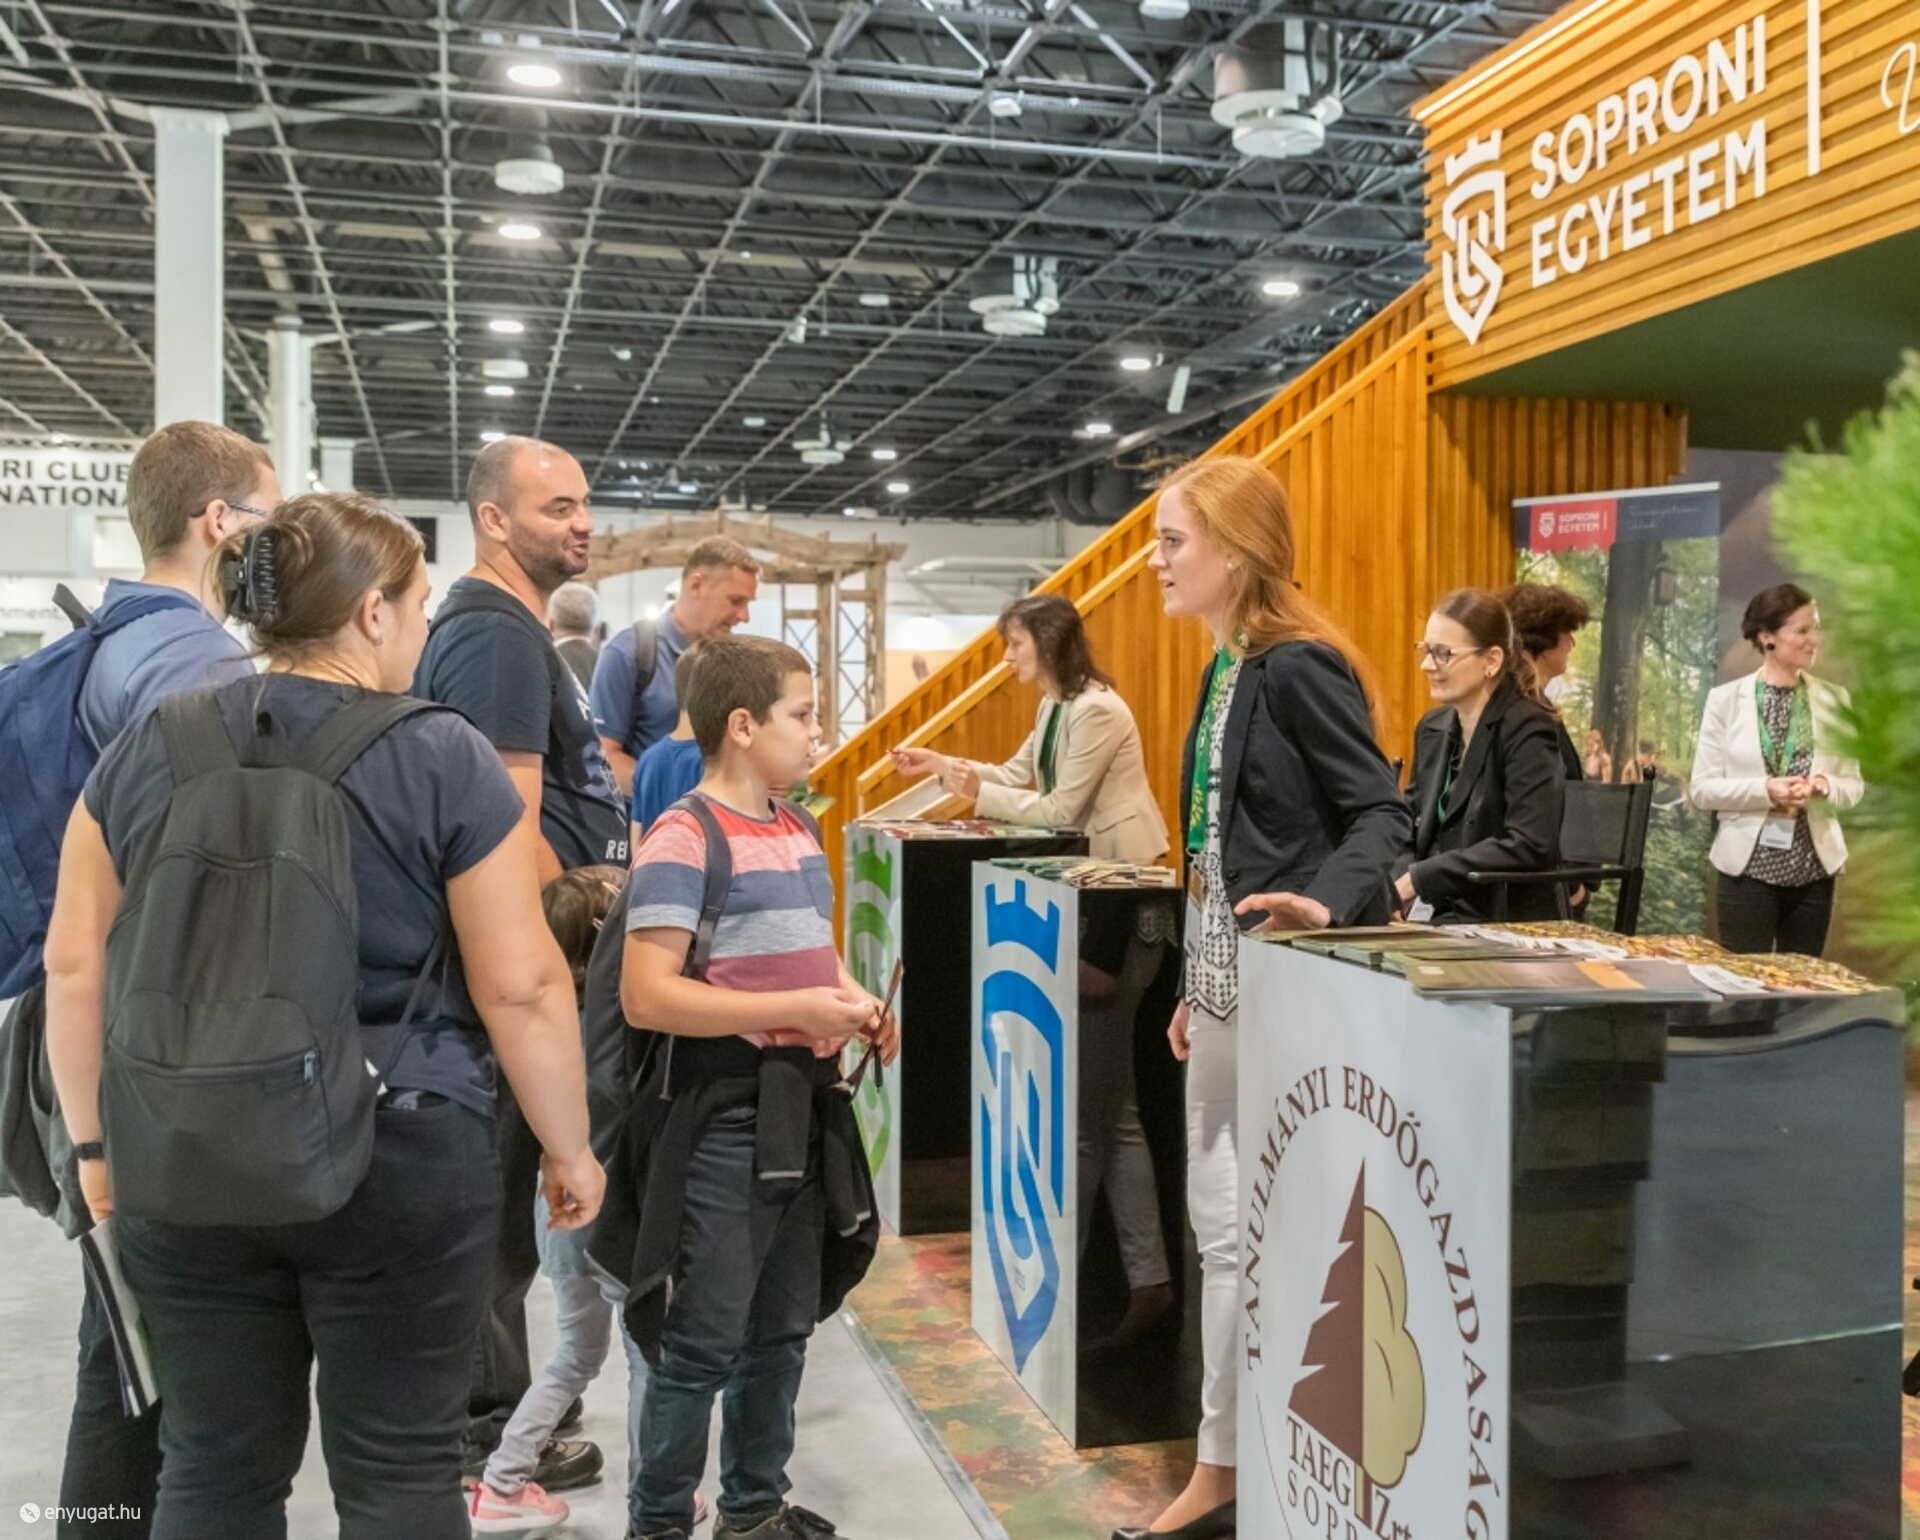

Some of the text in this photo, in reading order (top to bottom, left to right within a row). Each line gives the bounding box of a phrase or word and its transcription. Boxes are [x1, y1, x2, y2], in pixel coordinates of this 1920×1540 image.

[1531, 14, 1766, 200] SOPRONI
[1531, 119, 1766, 289] EGYETEM
[0, 485, 129, 507] NATION
[2, 458, 32, 479] RI
[1244, 1065, 1331, 1371] TANULMÁNYI
[1287, 1415, 1351, 1507] TAEG
